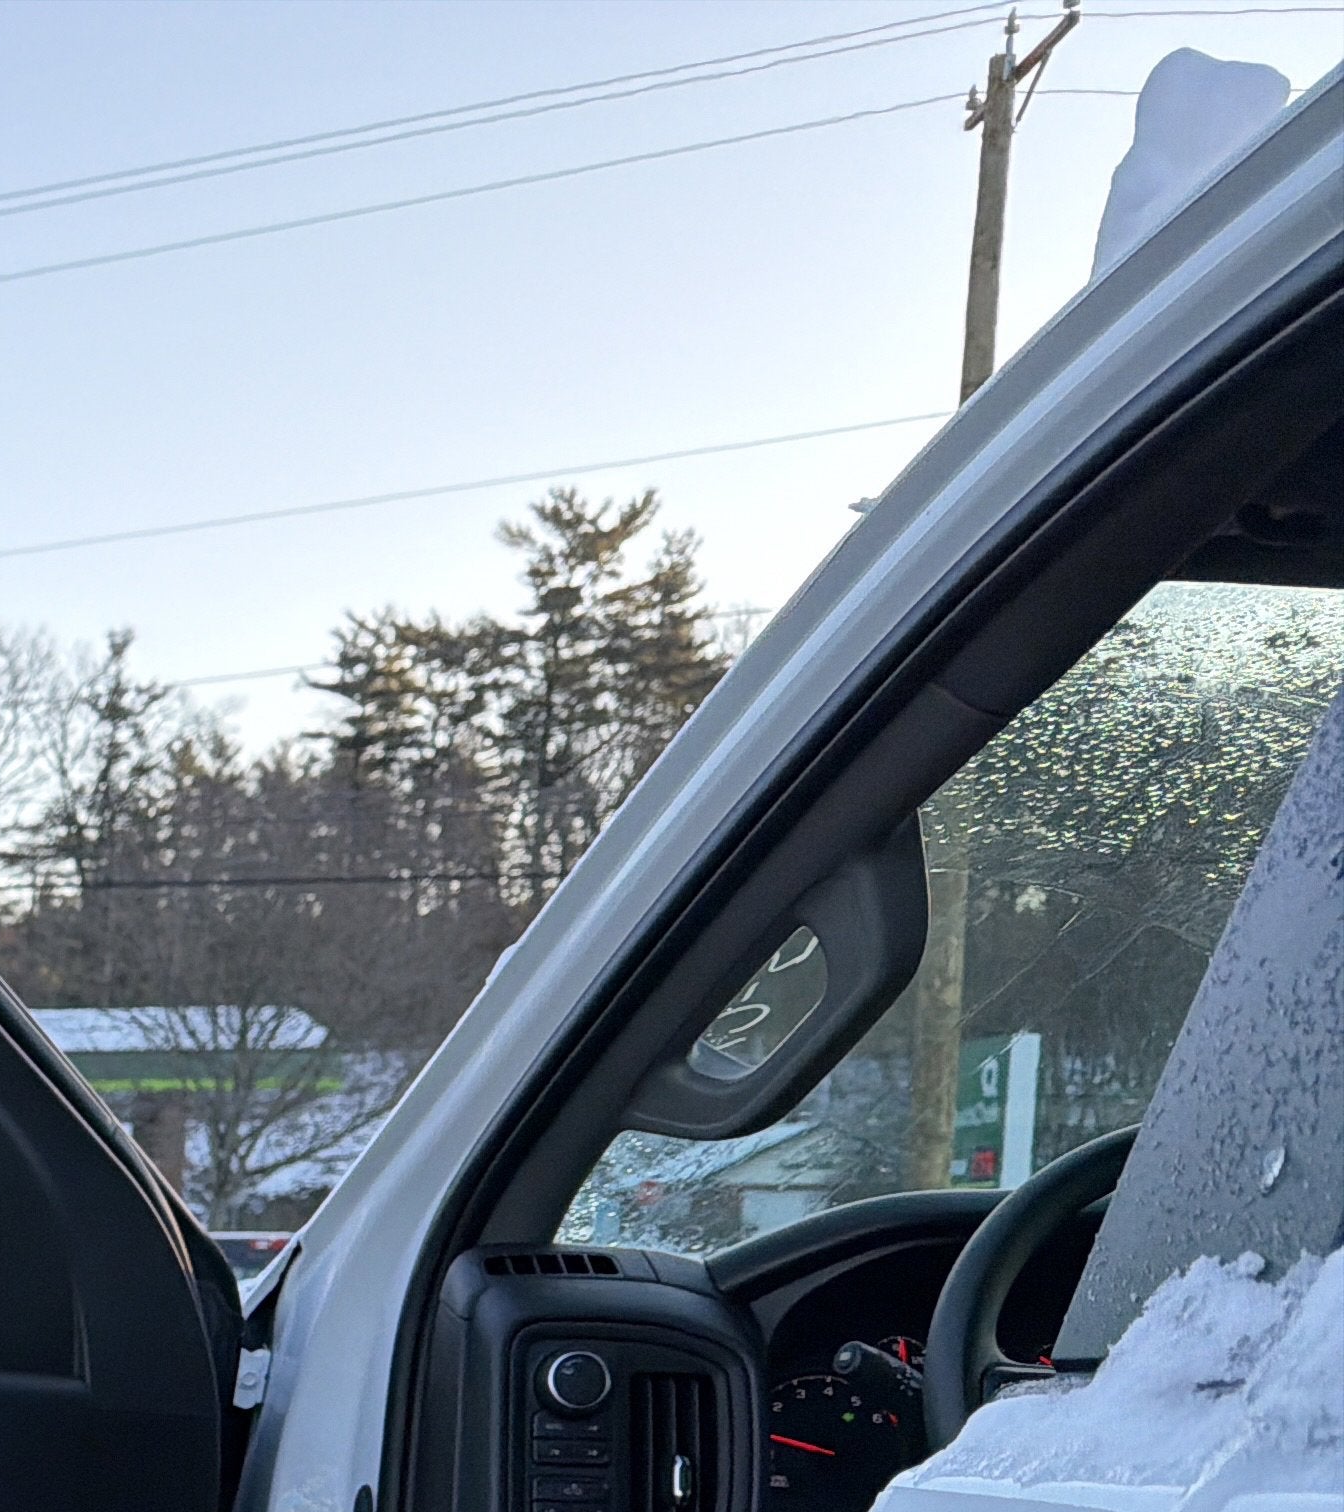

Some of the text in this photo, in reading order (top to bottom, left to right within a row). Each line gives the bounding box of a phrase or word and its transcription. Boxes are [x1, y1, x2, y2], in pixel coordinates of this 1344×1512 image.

[795, 1388, 806, 1399] 3
[823, 1386, 833, 1396] 4
[772, 1401, 783, 1412] 2
[850, 1395, 862, 1407] 5
[872, 1413, 883, 1424] 6
